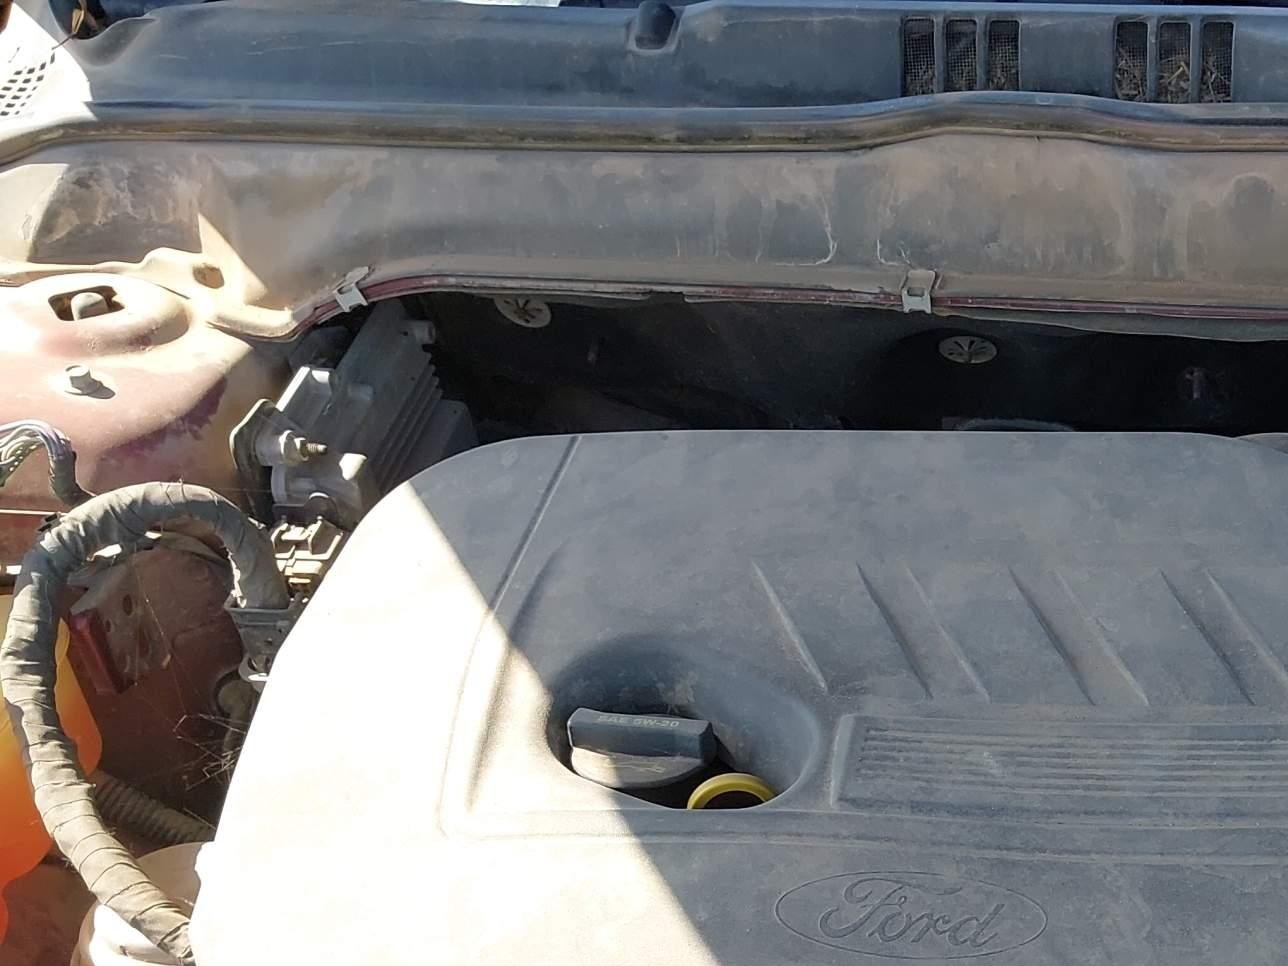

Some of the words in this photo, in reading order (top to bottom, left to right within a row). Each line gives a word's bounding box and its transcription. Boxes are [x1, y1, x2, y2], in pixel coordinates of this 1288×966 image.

[597, 715, 630, 725] SAE
[632, 717, 681, 729] 5W-20
[817, 877, 1006, 950] Ford
